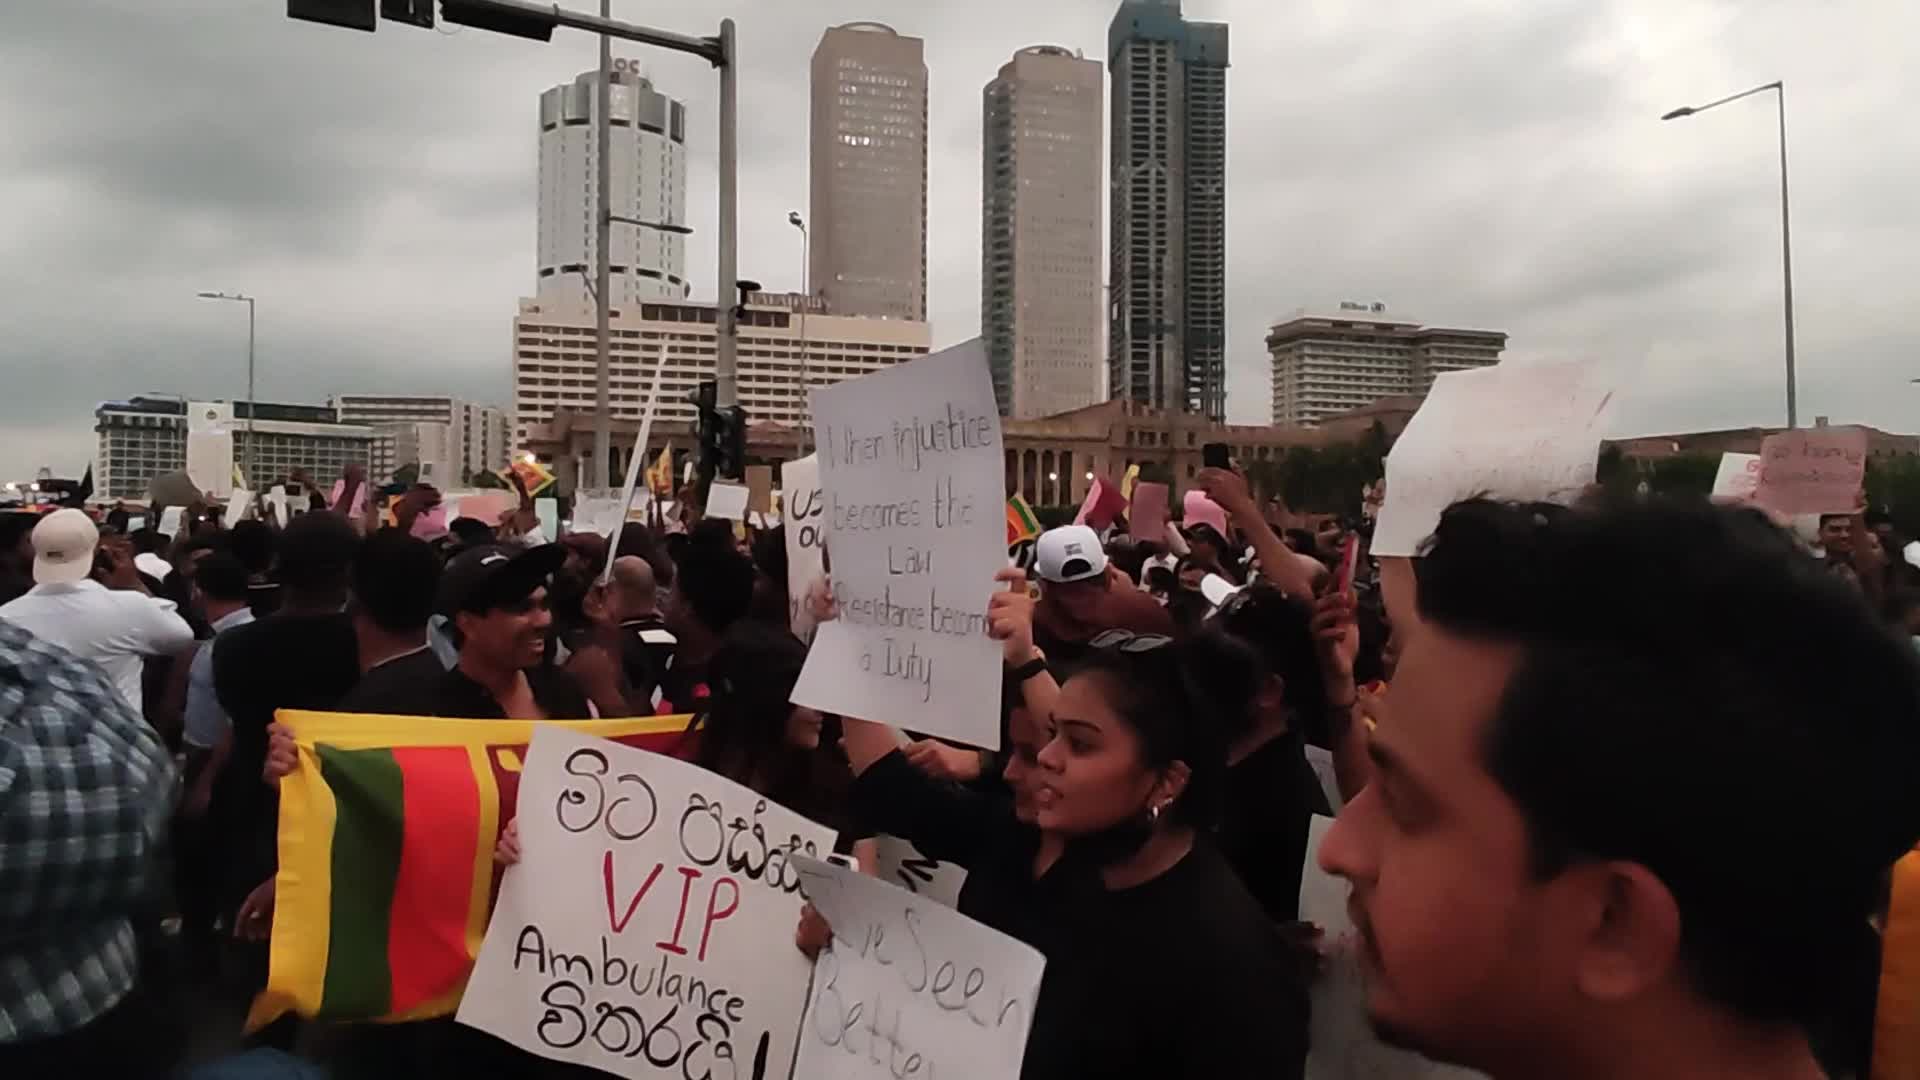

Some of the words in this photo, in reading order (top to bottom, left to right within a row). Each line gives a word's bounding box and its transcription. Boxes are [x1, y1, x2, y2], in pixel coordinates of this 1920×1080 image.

[833, 491, 921, 530] becomes
[933, 474, 974, 529] the
[888, 545, 932, 575] Law
[859, 651, 872, 672] a
[603, 850, 740, 961] VIP
[514, 925, 745, 1022] Ambulance
[904, 907, 1021, 1028] Seen
